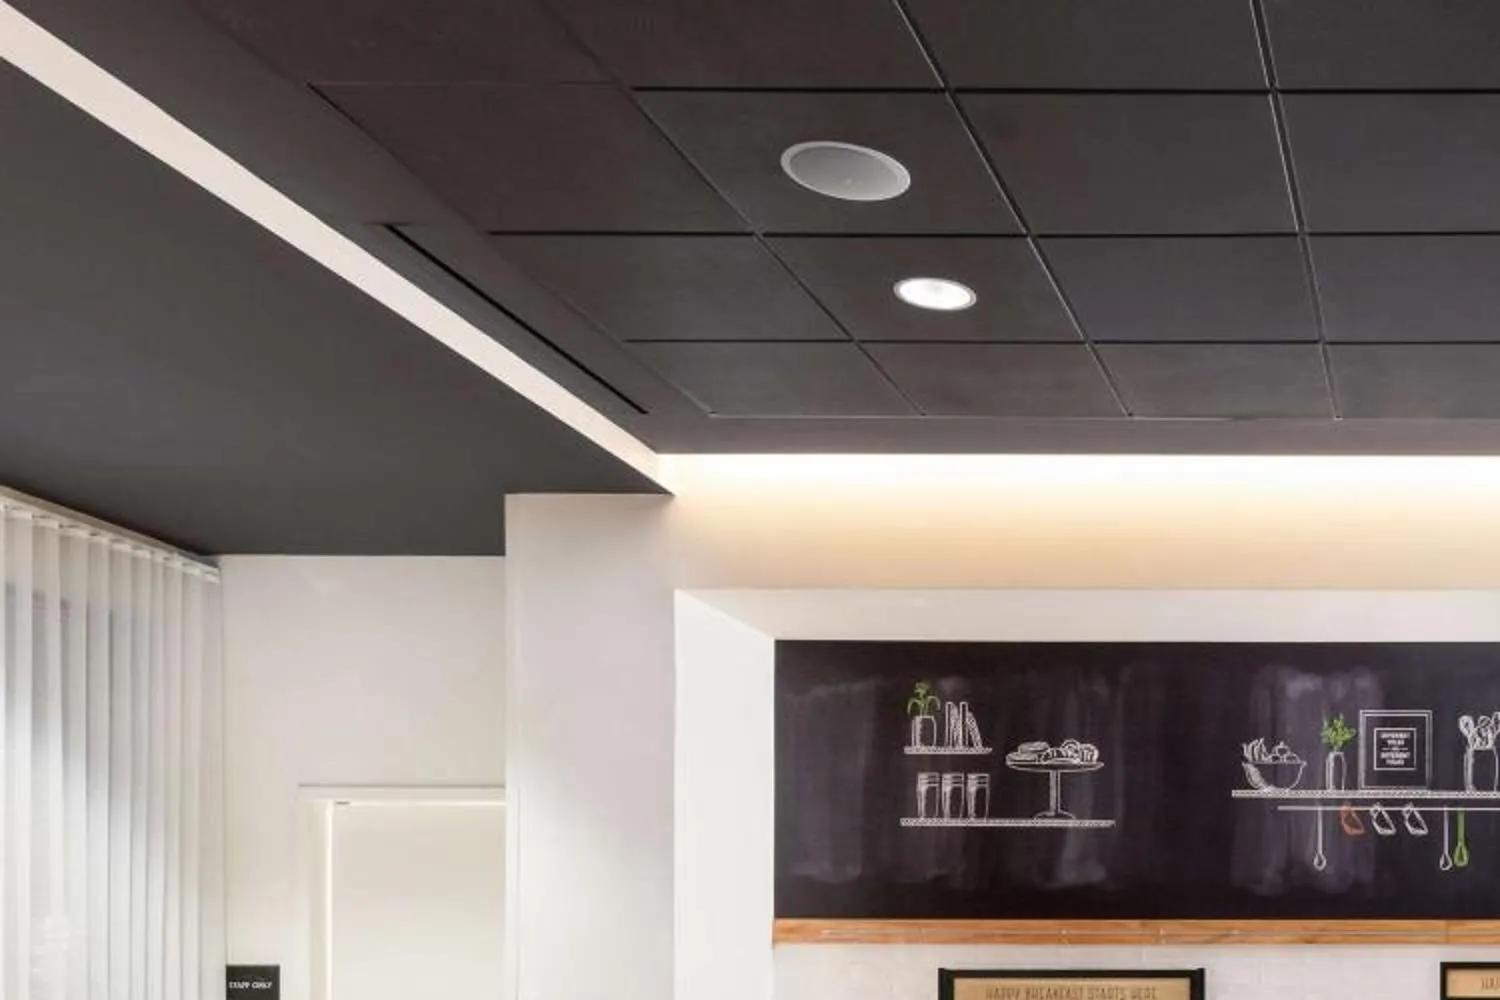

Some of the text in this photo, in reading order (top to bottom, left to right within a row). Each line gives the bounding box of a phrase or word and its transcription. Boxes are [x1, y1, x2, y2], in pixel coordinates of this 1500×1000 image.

[1025, 986, 1083, 1000] BREAKFAST
[1087, 986, 1125, 1000] STARTS
[1130, 986, 1158, 1000] HERE
